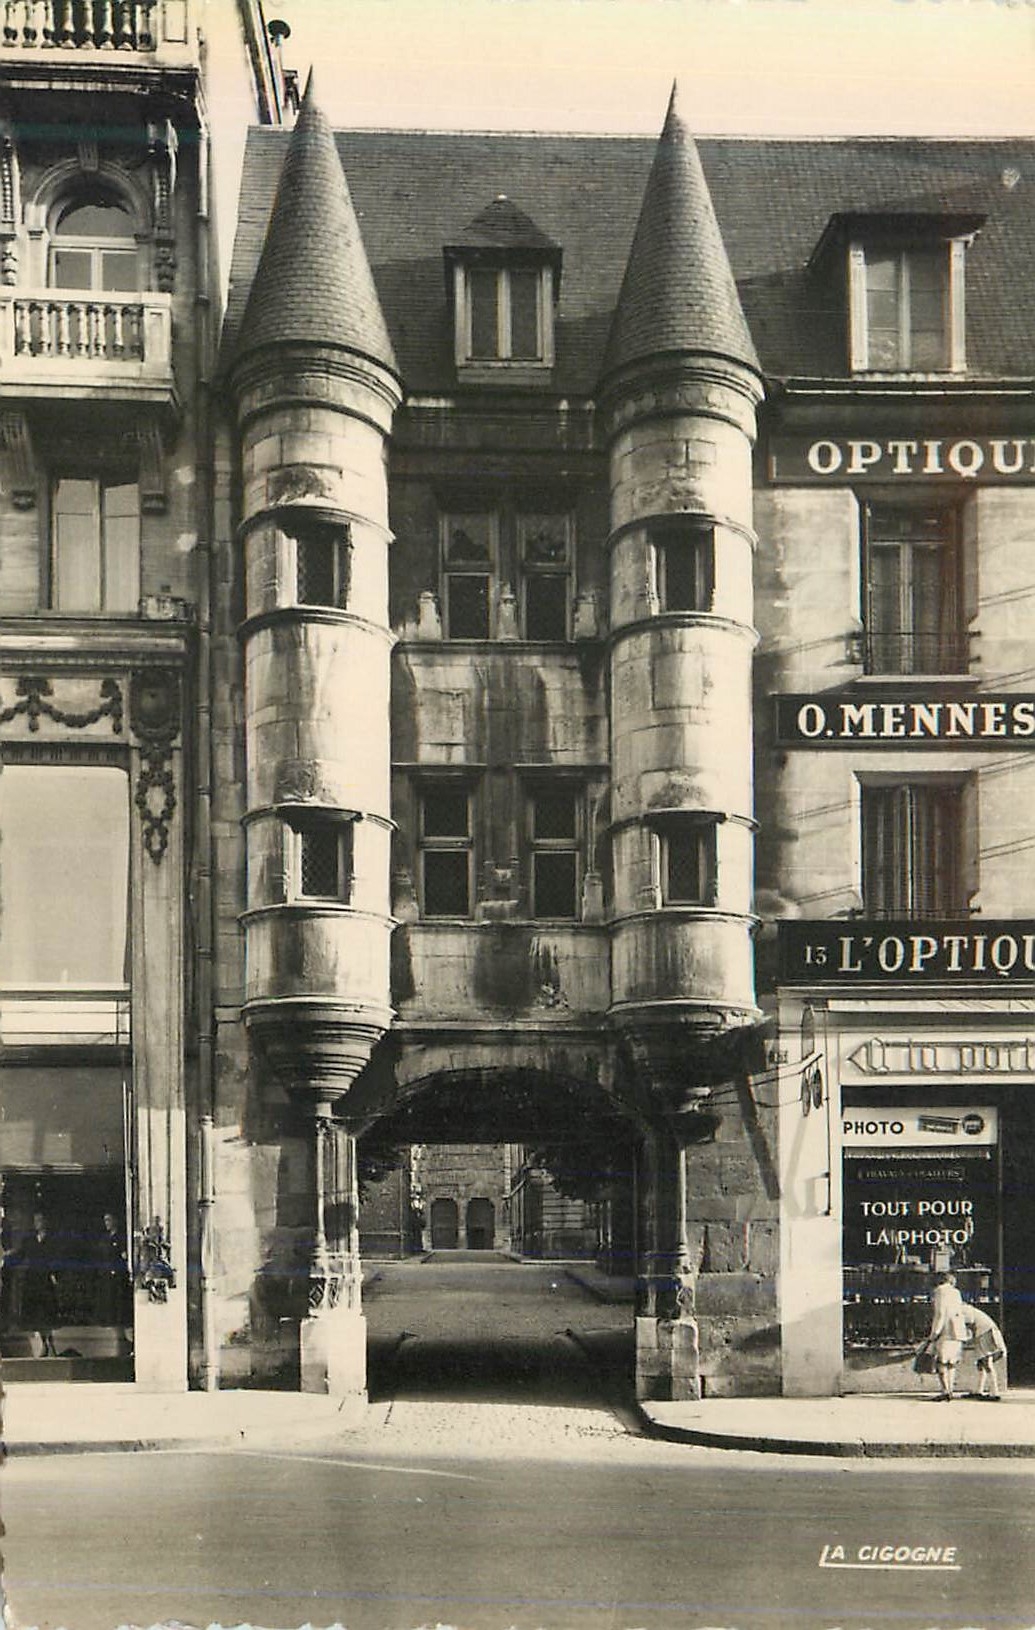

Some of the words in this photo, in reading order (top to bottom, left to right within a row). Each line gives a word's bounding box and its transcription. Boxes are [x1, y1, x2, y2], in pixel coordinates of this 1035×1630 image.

[807, 440, 1035, 478] OPTIQU
[842, 1121, 904, 1134] PHOTO
[860, 1201, 910, 1216] TOUT
[918, 1200, 973, 1216] POUR
[865, 1229, 890, 1246] LA
[897, 1229, 969, 1245] PHOTO
